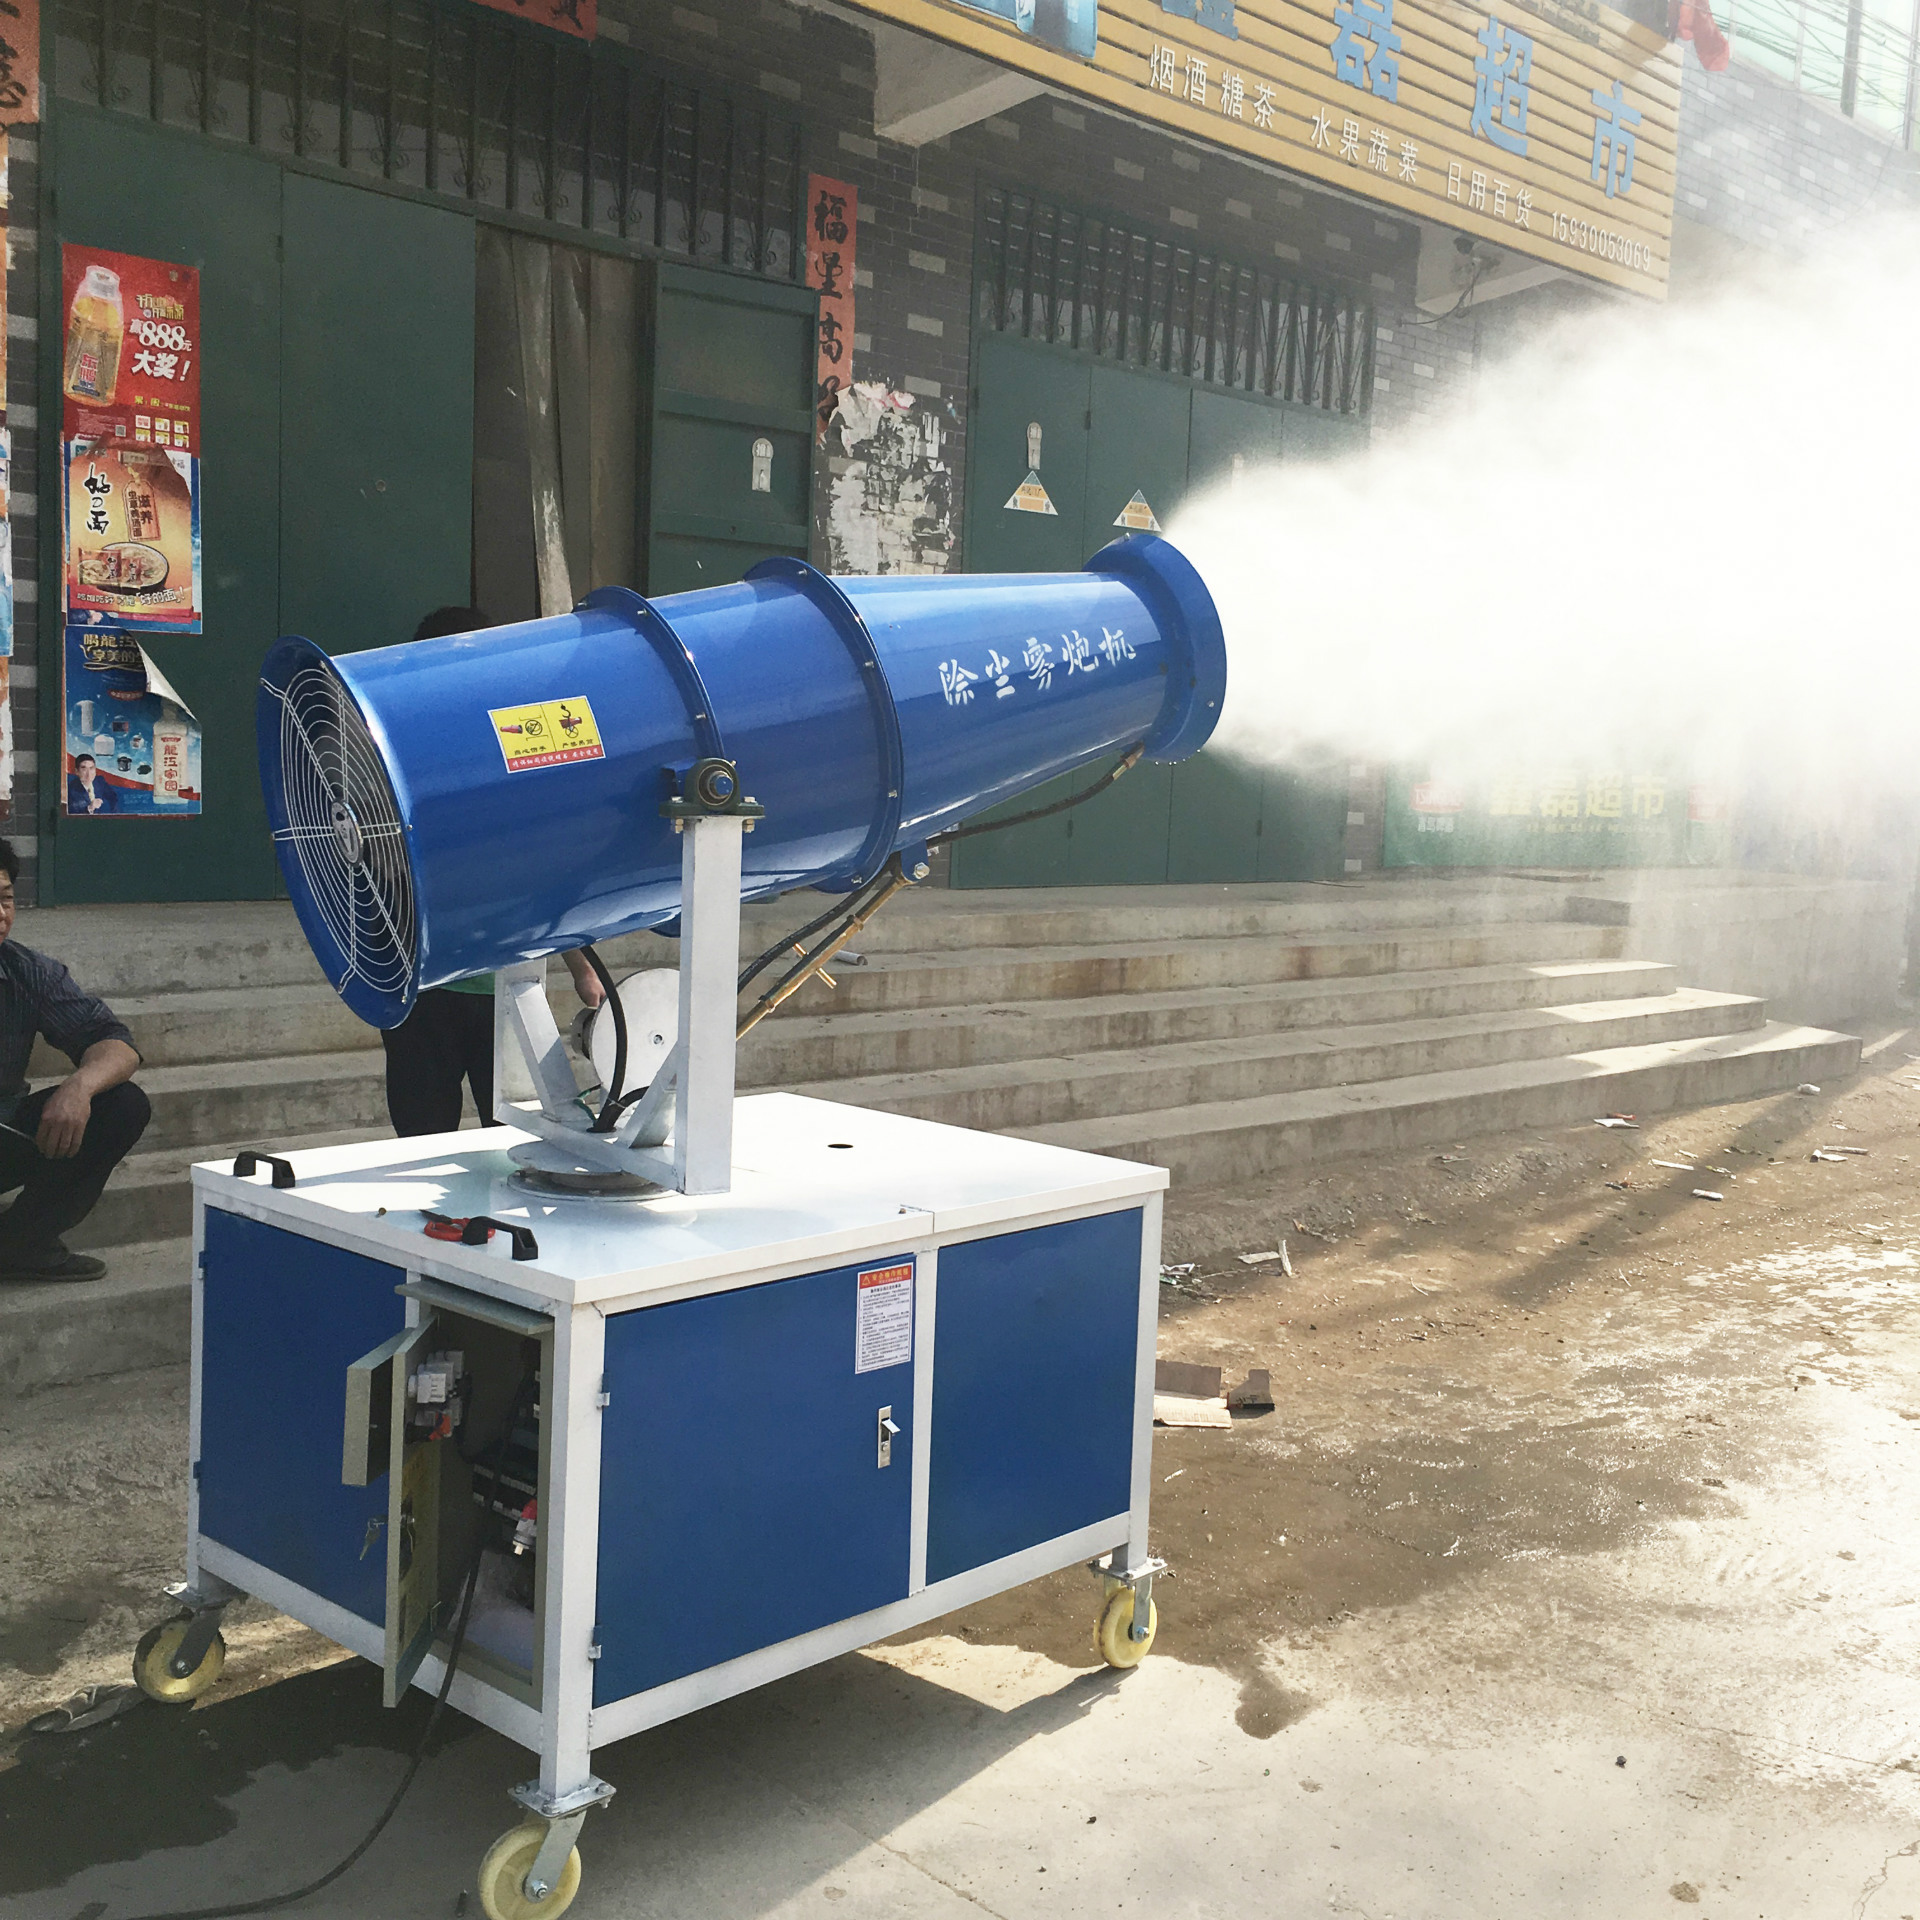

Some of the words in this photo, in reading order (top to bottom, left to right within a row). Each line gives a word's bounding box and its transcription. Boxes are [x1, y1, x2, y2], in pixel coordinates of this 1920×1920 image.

[1150, 44, 1276, 129] 烟酒糖茶
[1311, 106, 1419, 184] 水果蔬菜
[1447, 161, 1533, 229] 日用百货
[1551, 210, 1651, 272] 15930053069
[1162, 0, 1641, 199] 磊超市
[131, 350, 191, 381] 大奖!
[938, 626, 1137, 706] 除尘雾炮机
